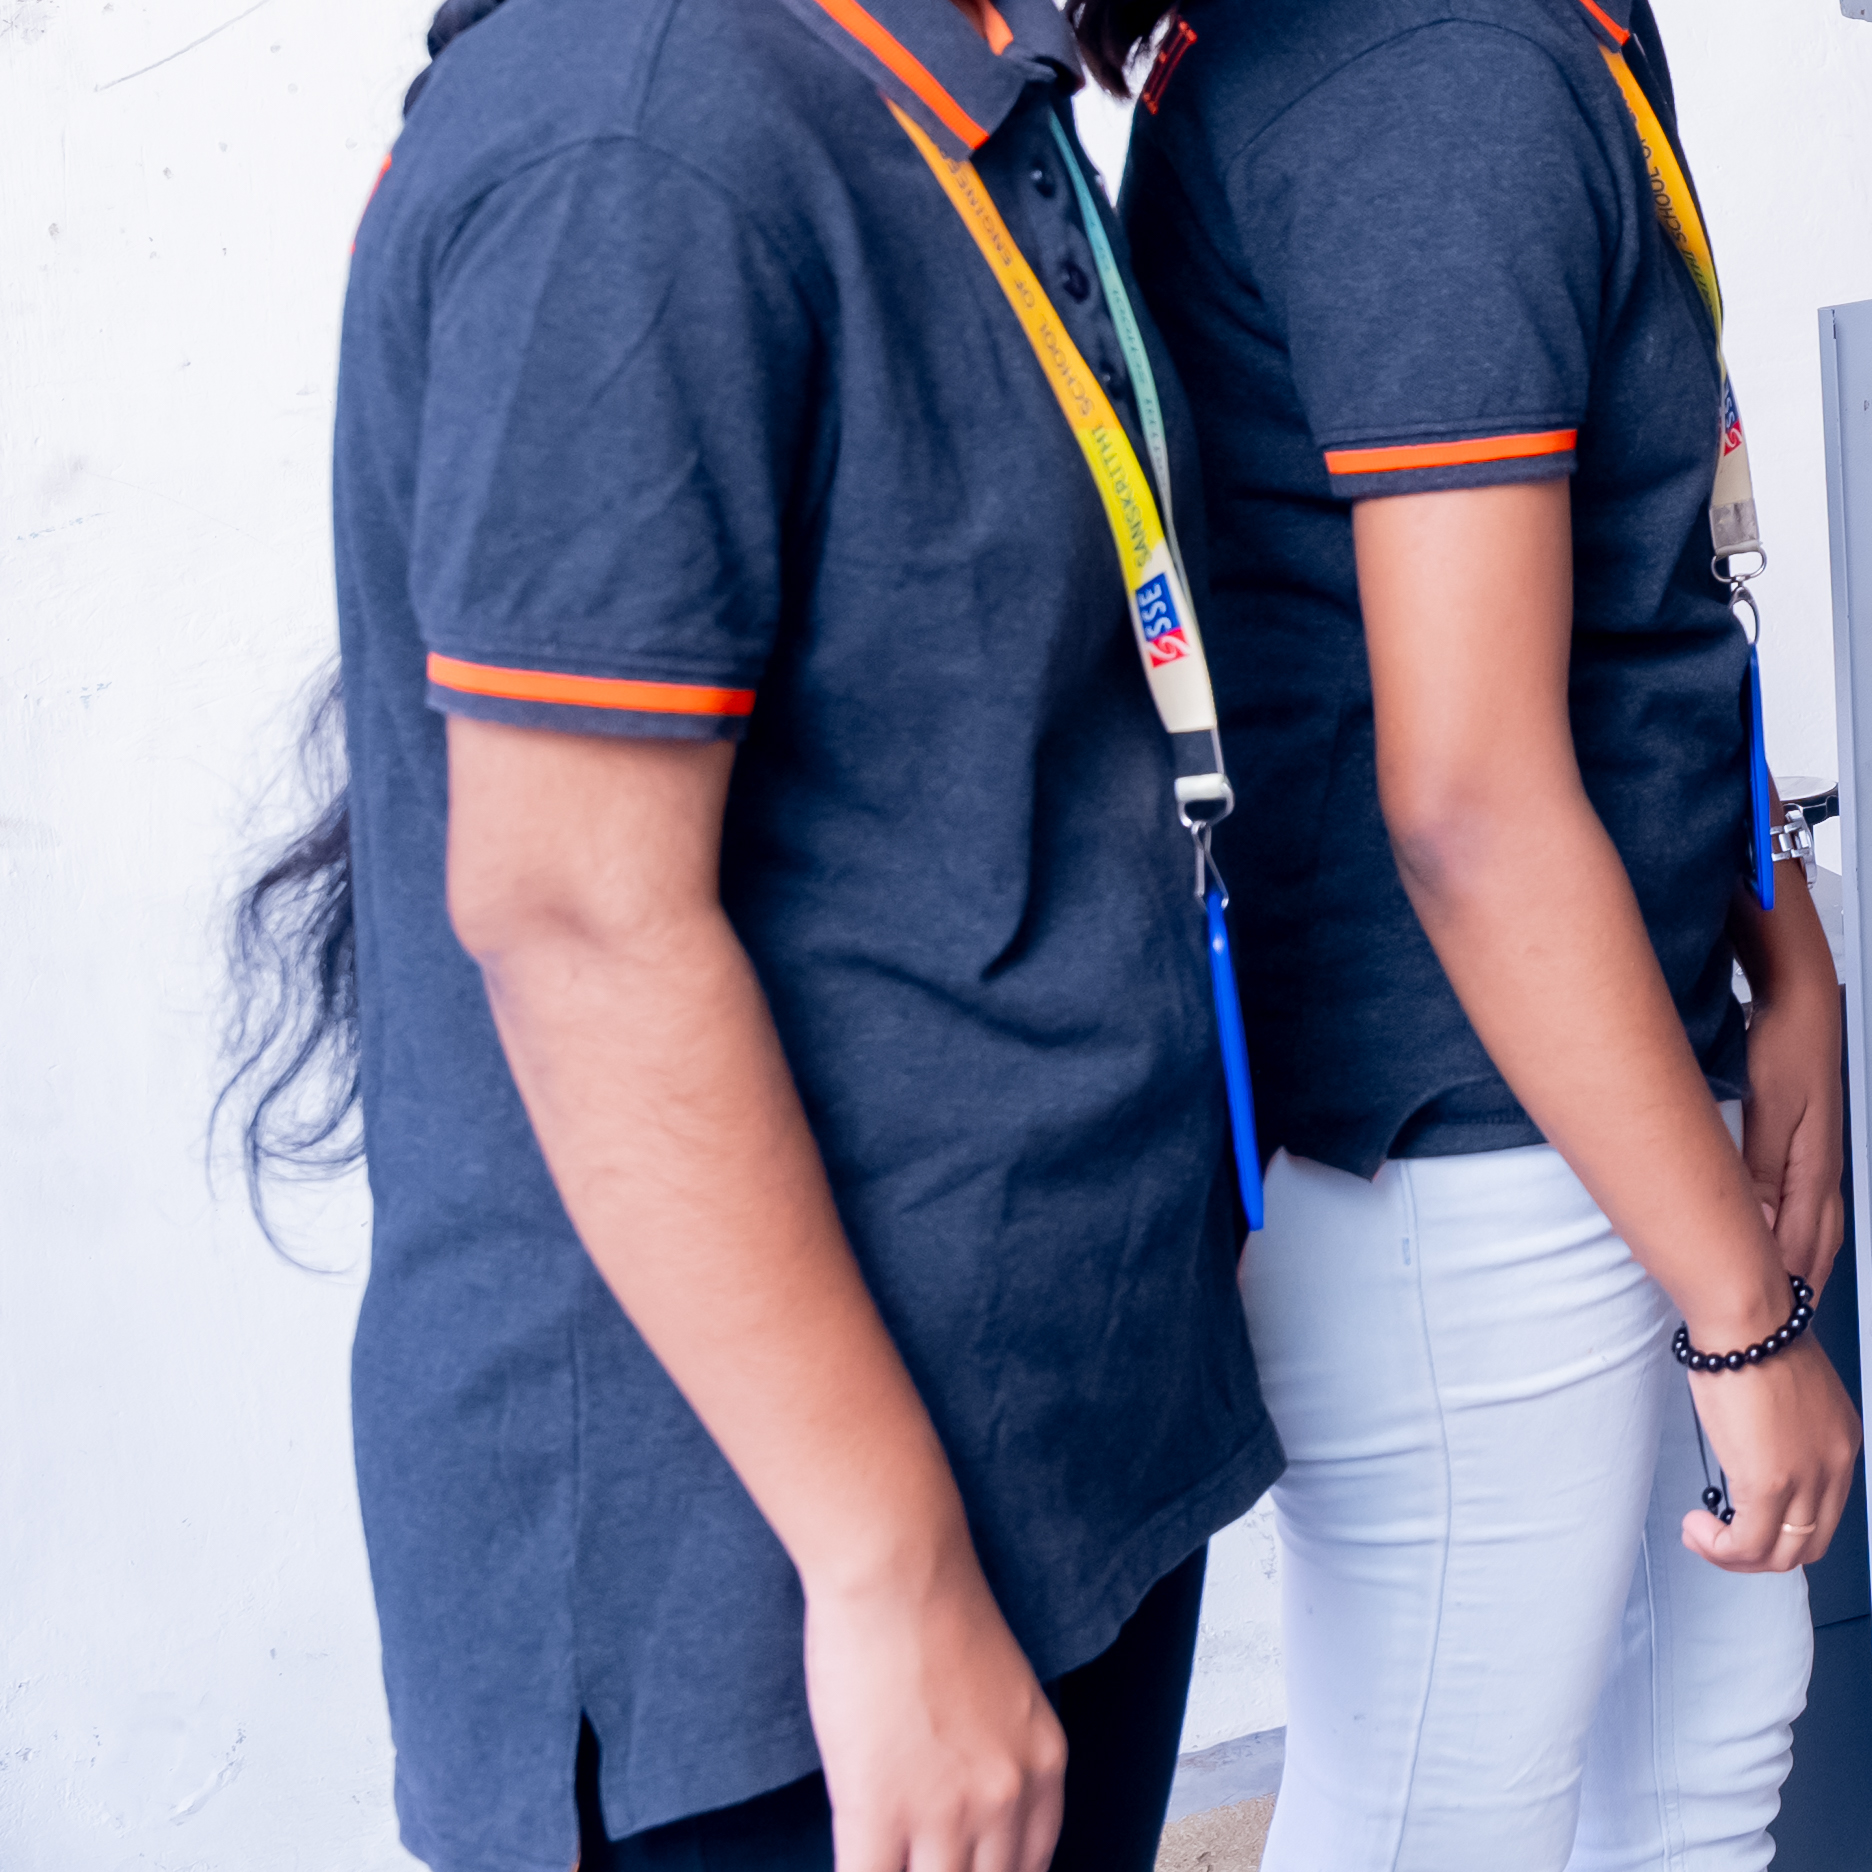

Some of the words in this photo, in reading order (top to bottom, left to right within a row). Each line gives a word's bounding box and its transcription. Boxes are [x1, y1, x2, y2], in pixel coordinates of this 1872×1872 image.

[1039, 326, 1094, 417] SCHOOL
[1092, 423, 1150, 568] SANSKRITHI
[1138, 583, 1172, 637] SSE
